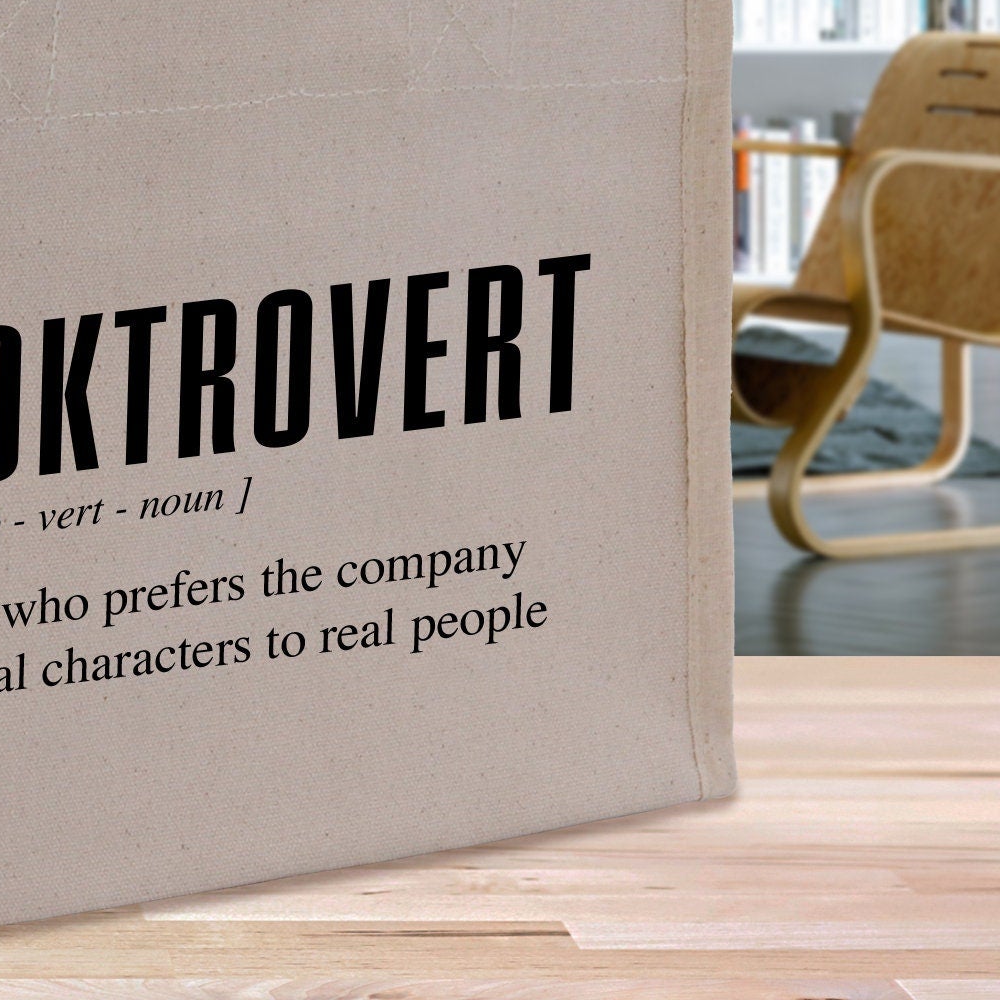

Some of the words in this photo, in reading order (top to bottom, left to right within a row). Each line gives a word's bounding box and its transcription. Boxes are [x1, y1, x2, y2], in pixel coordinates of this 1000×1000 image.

[38, 498, 106, 532] vert
[139, 488, 225, 520] noun
[1, 585, 90, 629] who
[102, 569, 246, 628] prefers
[260, 557, 324, 598] the
[336, 540, 528, 589] company
[41, 635, 252, 688] characters
[265, 627, 307, 660] to
[317, 607, 396, 655] real
[409, 590, 549, 655] people
